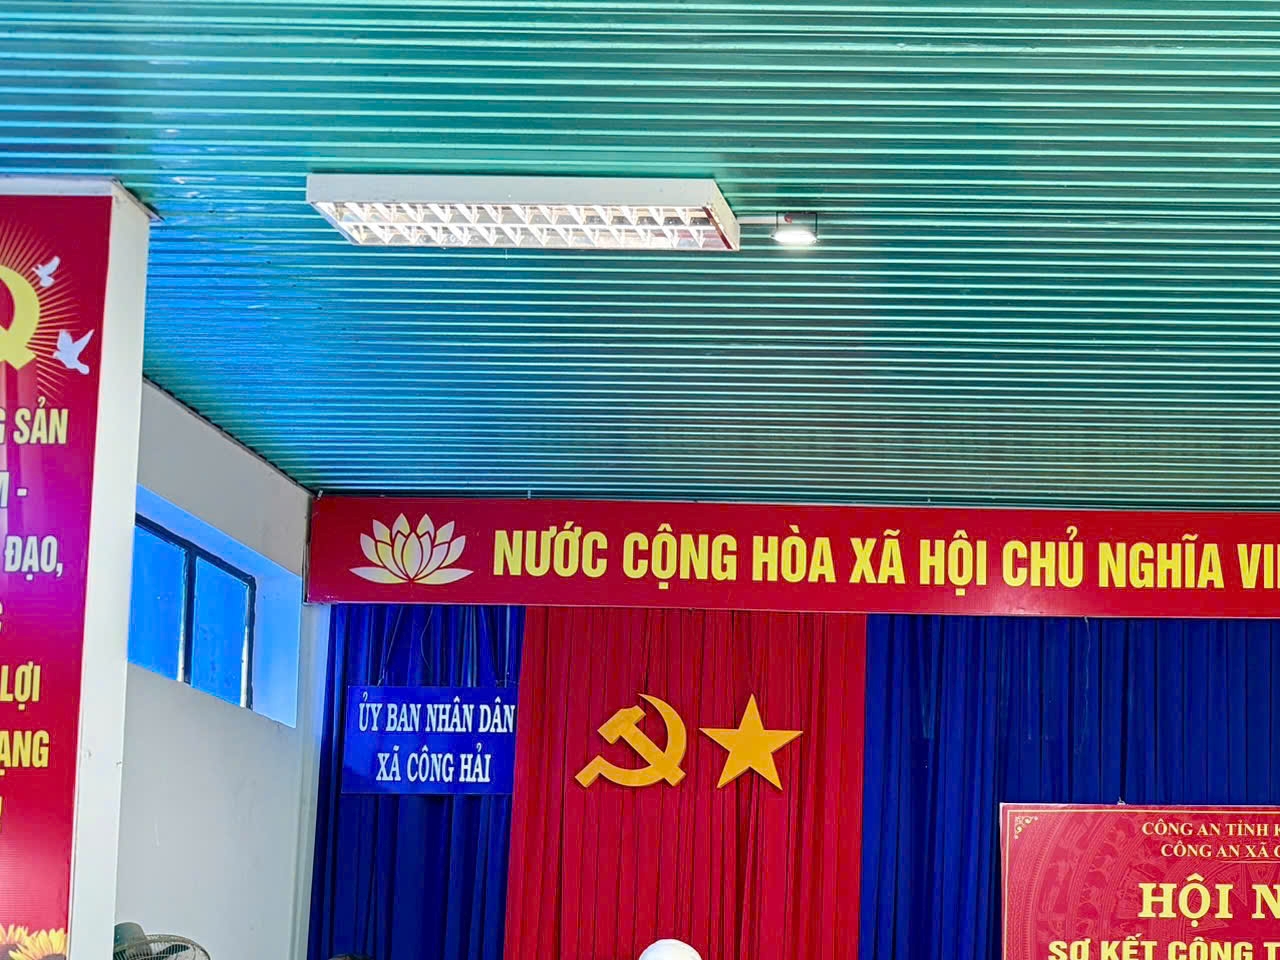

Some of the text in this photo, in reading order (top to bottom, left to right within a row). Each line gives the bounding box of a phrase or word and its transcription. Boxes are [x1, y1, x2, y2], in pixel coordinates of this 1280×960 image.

[13, 396, 69, 445] SẢN
[5, 535, 63, 581] ĐẠO,
[493, 521, 608, 578] NƯỚC
[623, 523, 737, 590] CỘNG
[752, 525, 836, 583] HÒA
[849, 529, 906, 585] XÃ
[919, 529, 987, 596] HỘI
[1002, 525, 1083, 587] CHỦ
[1098, 533, 1225, 589] NGHĨA
[0, 661, 41, 710] LỢI
[359, 691, 515, 732] ỦY BAN NHÂN DÂN
[376, 743, 491, 782] XÃ CÔNG HẢI
[1142, 818, 1193, 836] CÔNG
[1197, 823, 1221, 836] AN
[1226, 819, 1268, 837] TỈNH
[1160, 840, 1212, 857] CÔNG
[1216, 845, 1240, 858] AN
[1245, 841, 1269, 858] XÃ
[1137, 872, 1234, 928] HỘI
